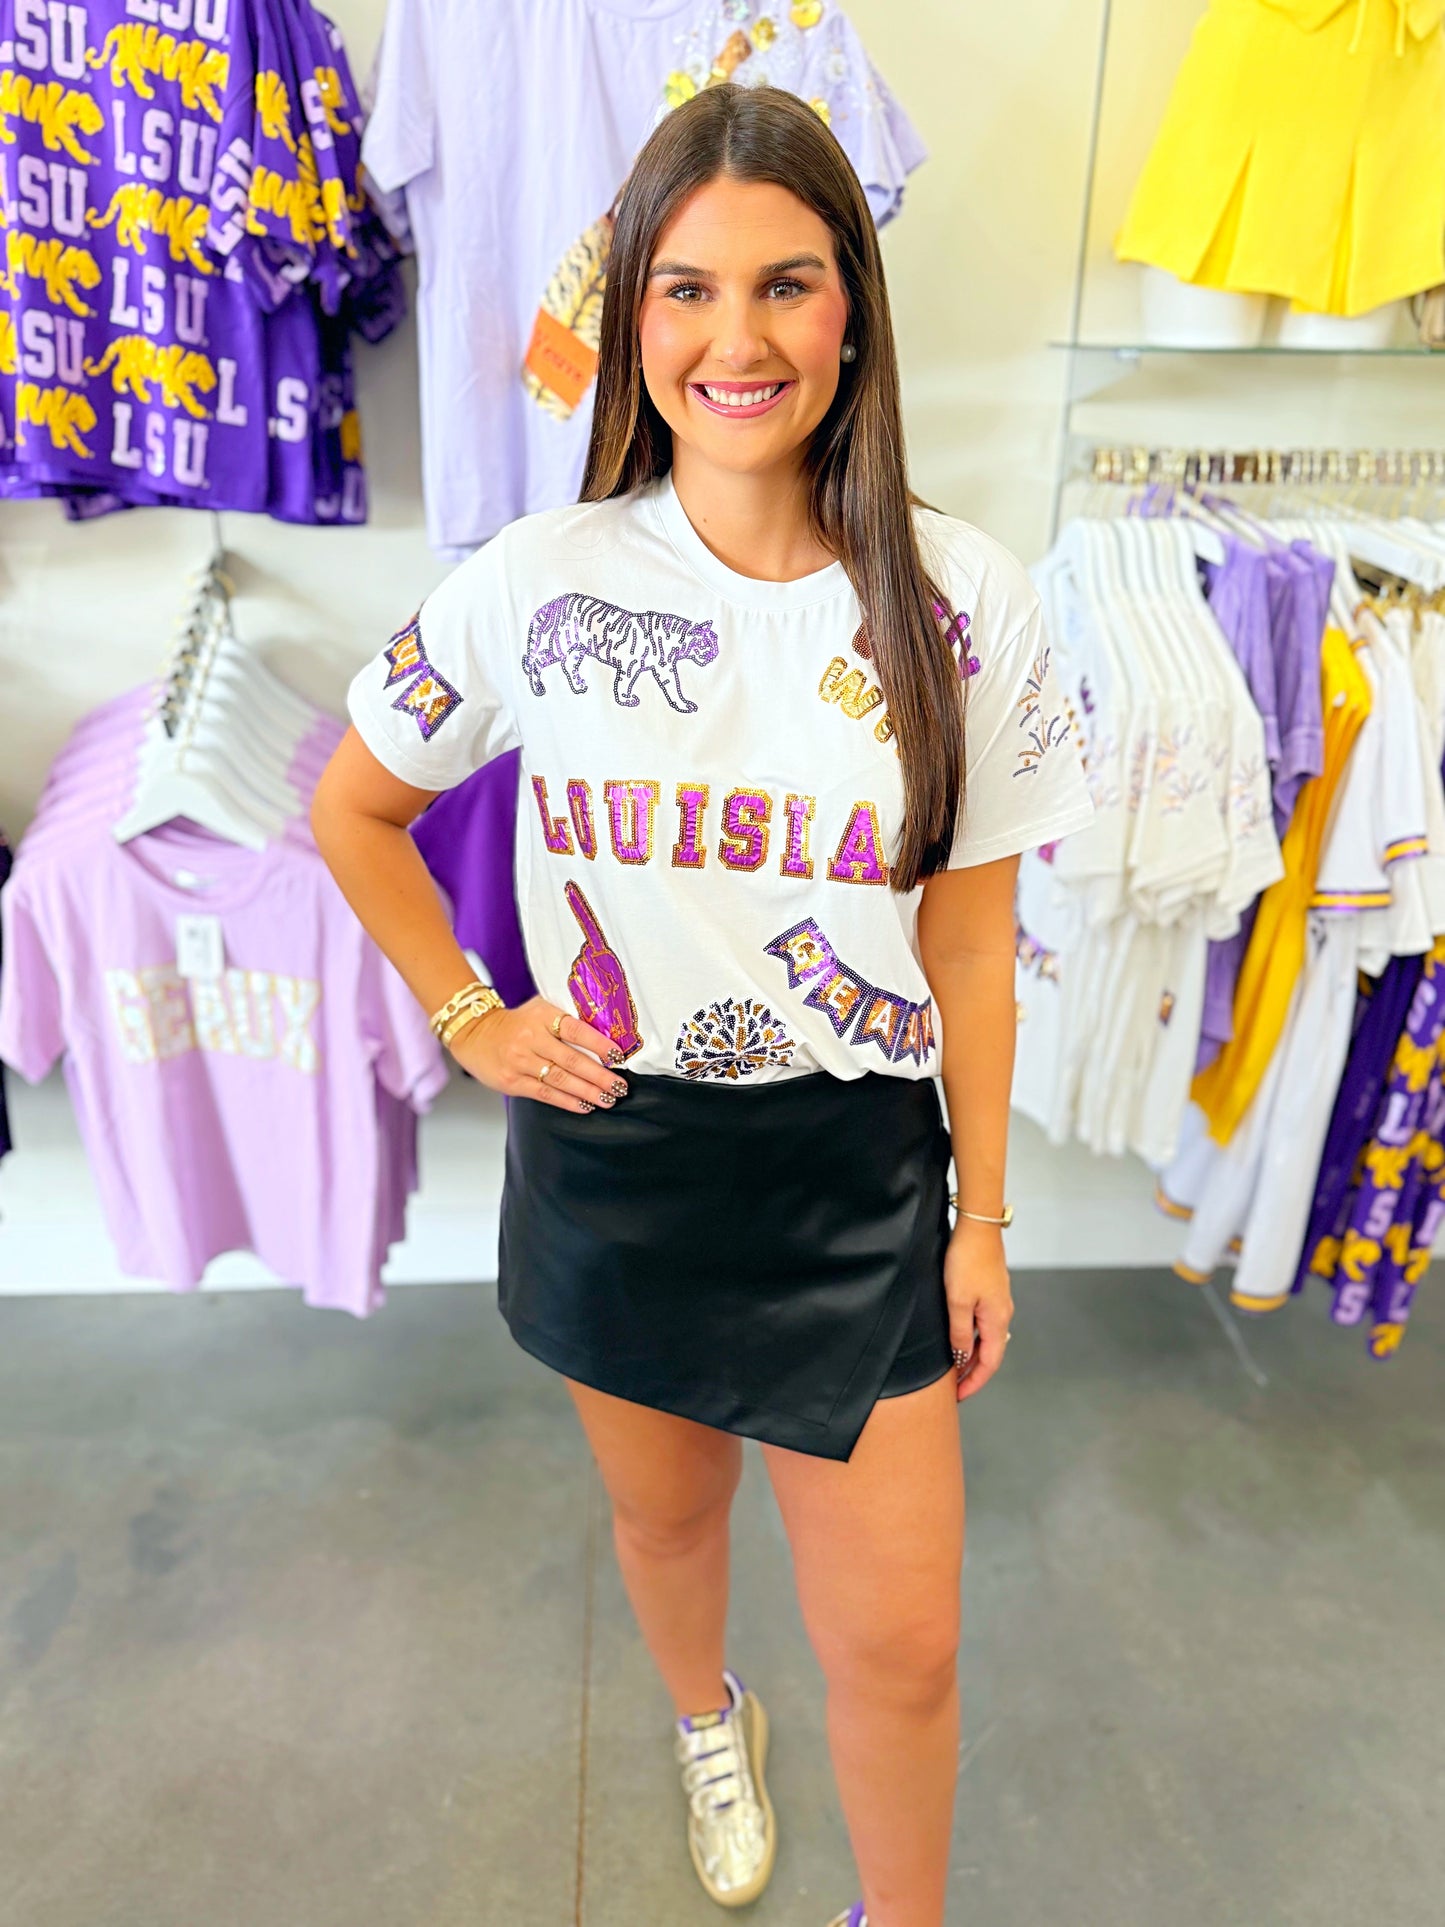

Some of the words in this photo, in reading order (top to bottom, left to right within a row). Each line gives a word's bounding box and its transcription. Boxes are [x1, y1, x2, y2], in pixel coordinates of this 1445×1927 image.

[112, 99, 218, 195] LSU
[110, 256, 209, 345] LSU
[111, 401, 209, 488] LSU
[104, 964, 321, 1077] GEAUX
